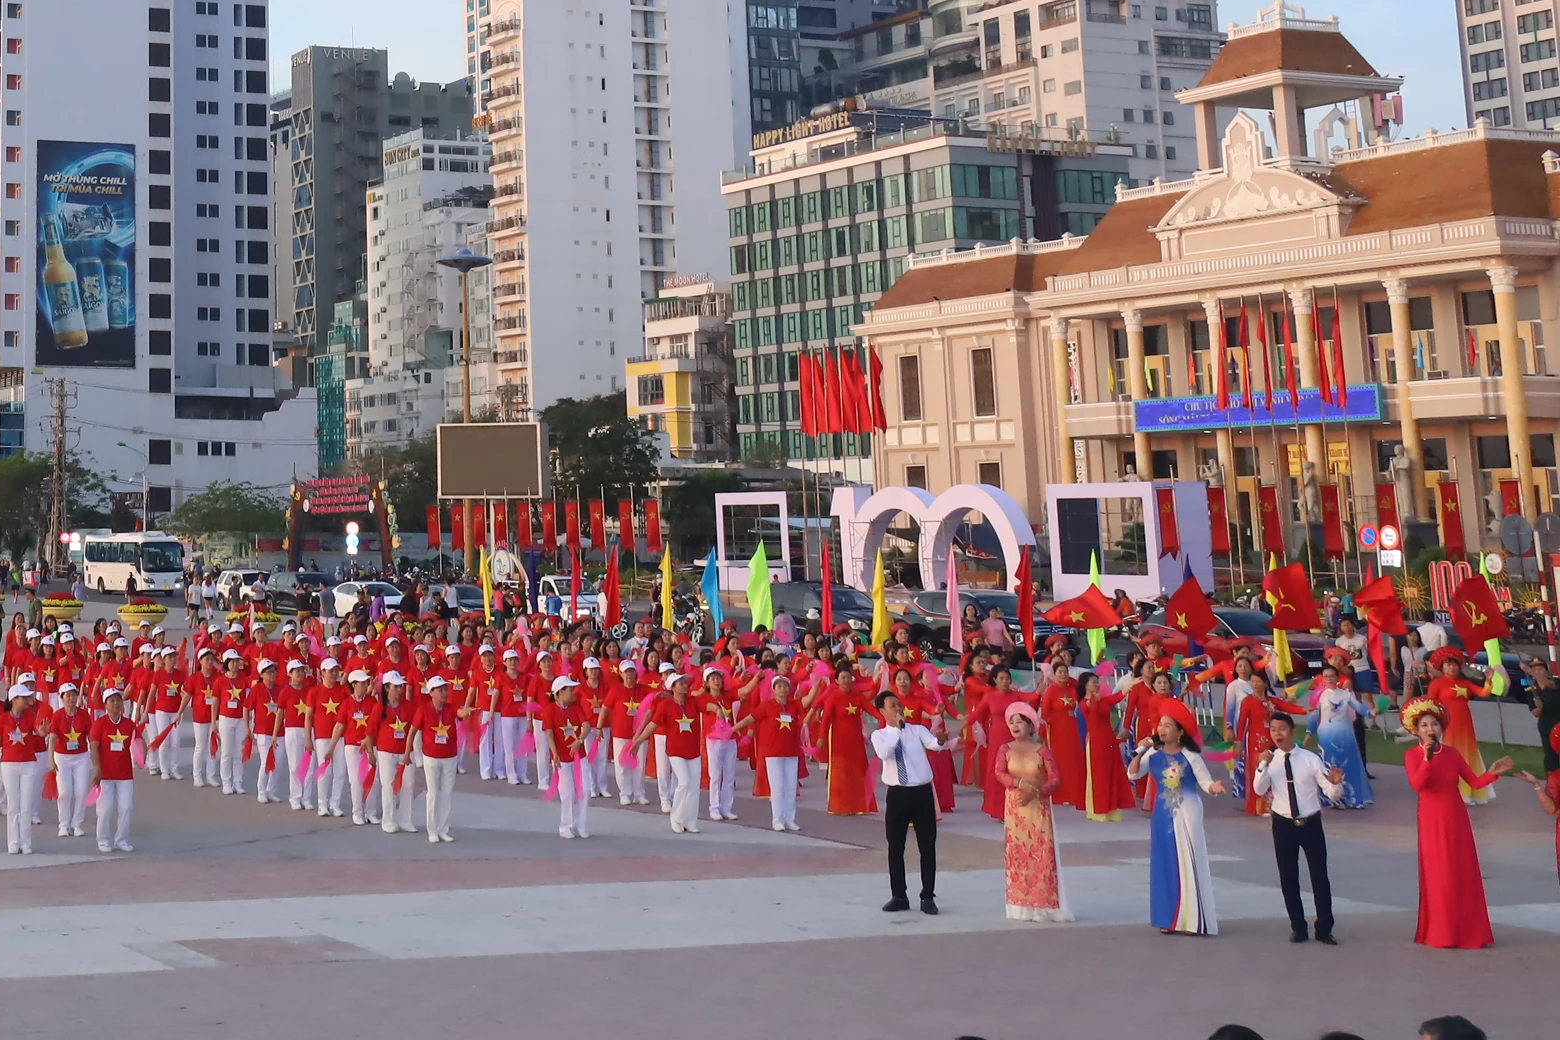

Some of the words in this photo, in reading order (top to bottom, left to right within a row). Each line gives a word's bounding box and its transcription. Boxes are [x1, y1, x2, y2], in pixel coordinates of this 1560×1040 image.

[753, 128, 784, 149] HAPPY
[786, 119, 816, 141] LIGHT
[818, 110, 851, 133] HOTEL
[100, 176, 127, 185] CHILL
[95, 186, 122, 194] CHILL
[674, 274, 691, 286] MOON
[691, 272, 709, 283] HOTEL
